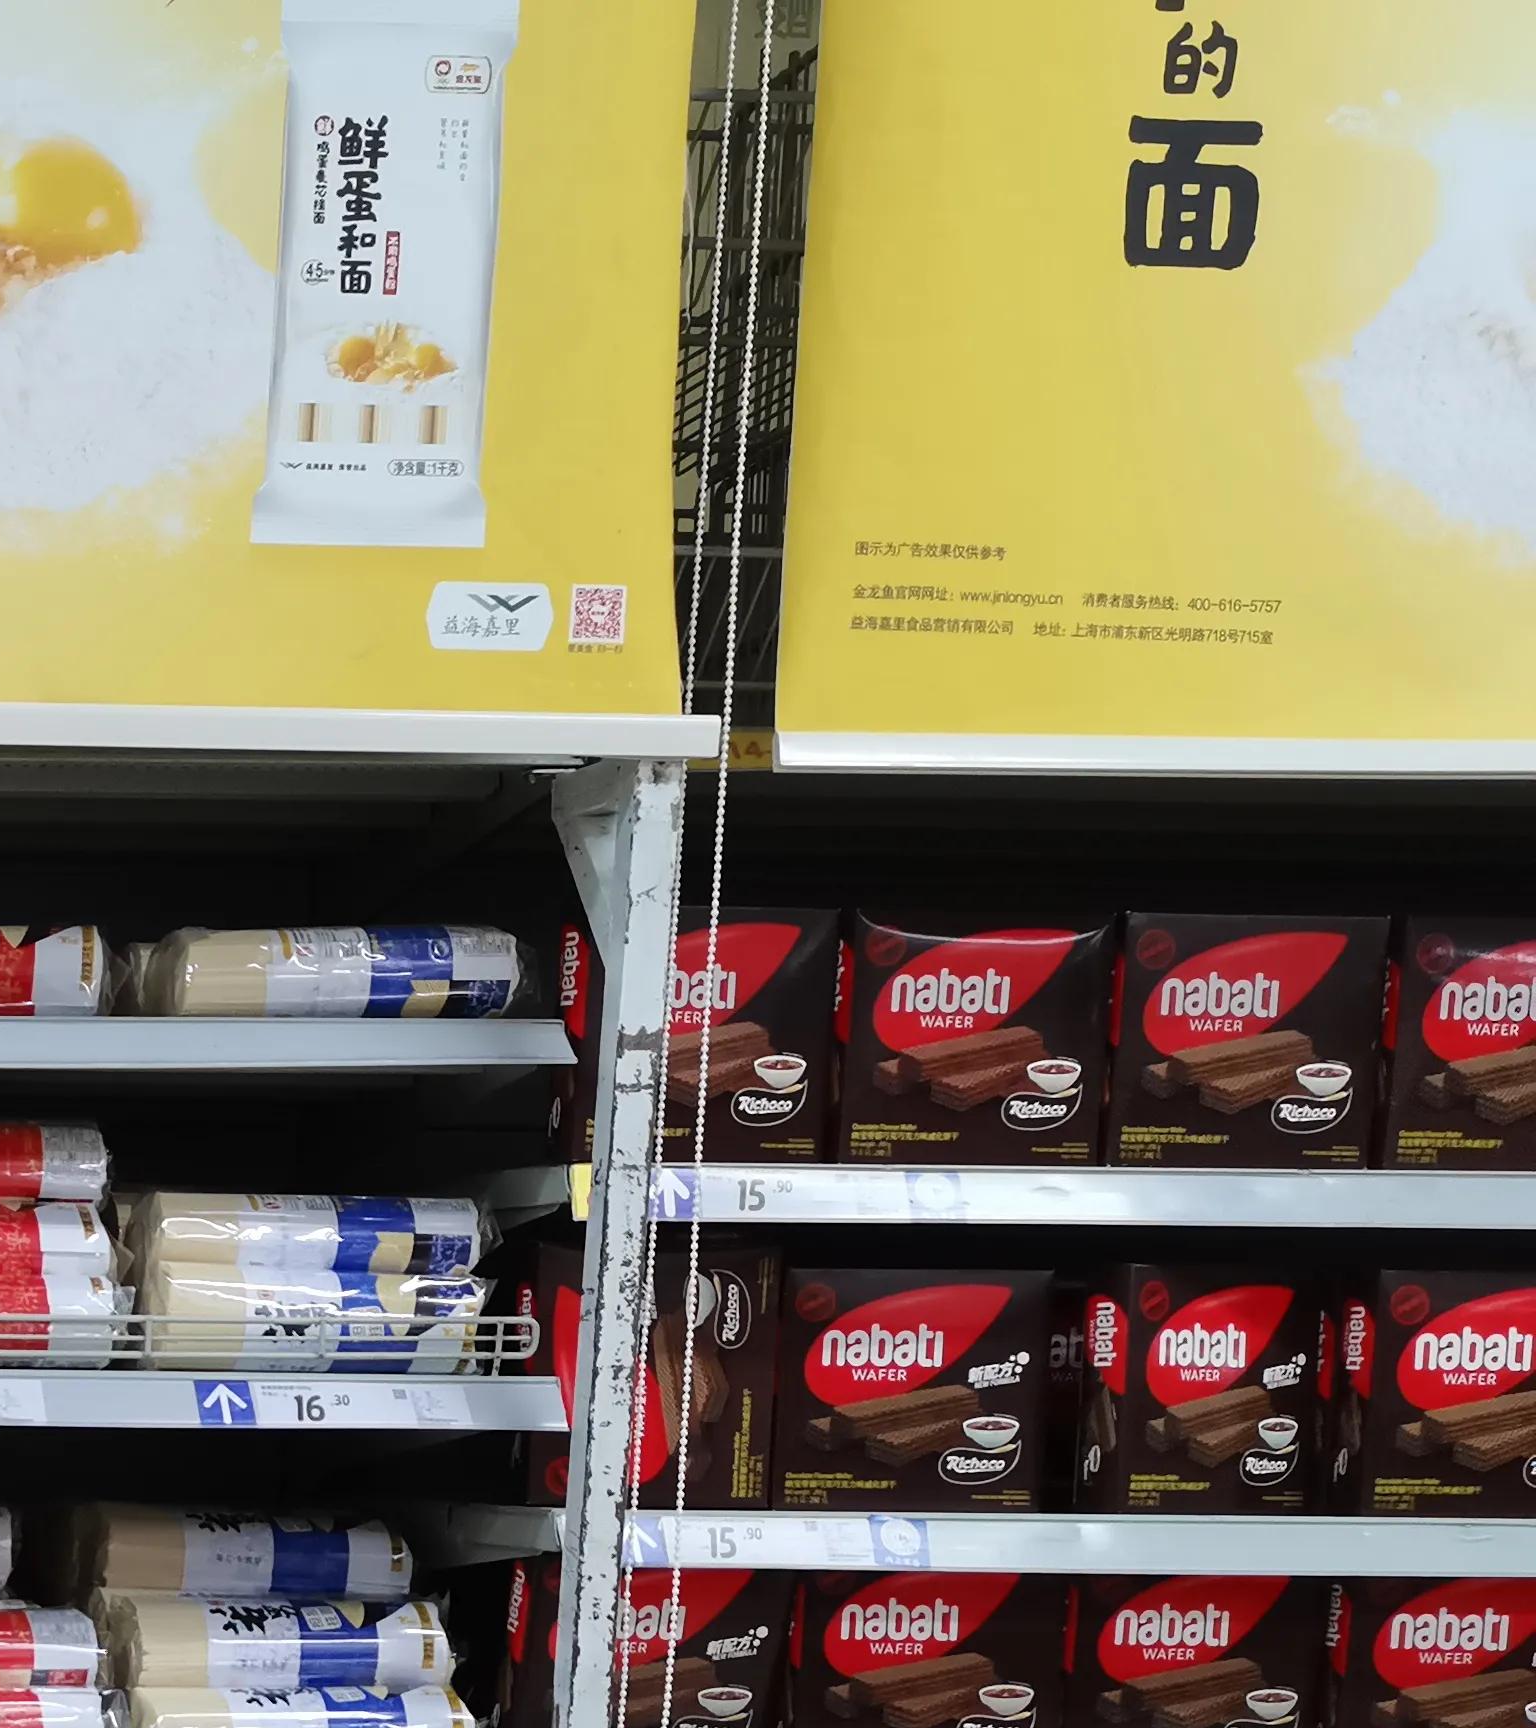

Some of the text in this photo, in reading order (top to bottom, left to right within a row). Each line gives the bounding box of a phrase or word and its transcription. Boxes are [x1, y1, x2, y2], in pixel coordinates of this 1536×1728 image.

[1124, 0, 1263, 270] 的面
[336, 116, 388, 294] 鲜蛋和面
[440, 615, 520, 637] 益海嘉里
[891, 967, 1009, 1015] nabati
[1161, 971, 1279, 1019] nabati
[920, 1014, 974, 1029] WAFER
[1009, 1101, 1067, 1121] Richoco
[822, 1326, 943, 1369] nabati
[1092, 1301, 1115, 1367] nabati
[1158, 1326, 1246, 1369] nabati
[851, 1368, 907, 1383] WAFER
[969, 1364, 1016, 1382] 新配方
[947, 1453, 1006, 1472] Richoco
[841, 1604, 959, 1645] nabati
[1391, 1608, 1510, 1652] nabati
[869, 1642, 924, 1656] WAFER
